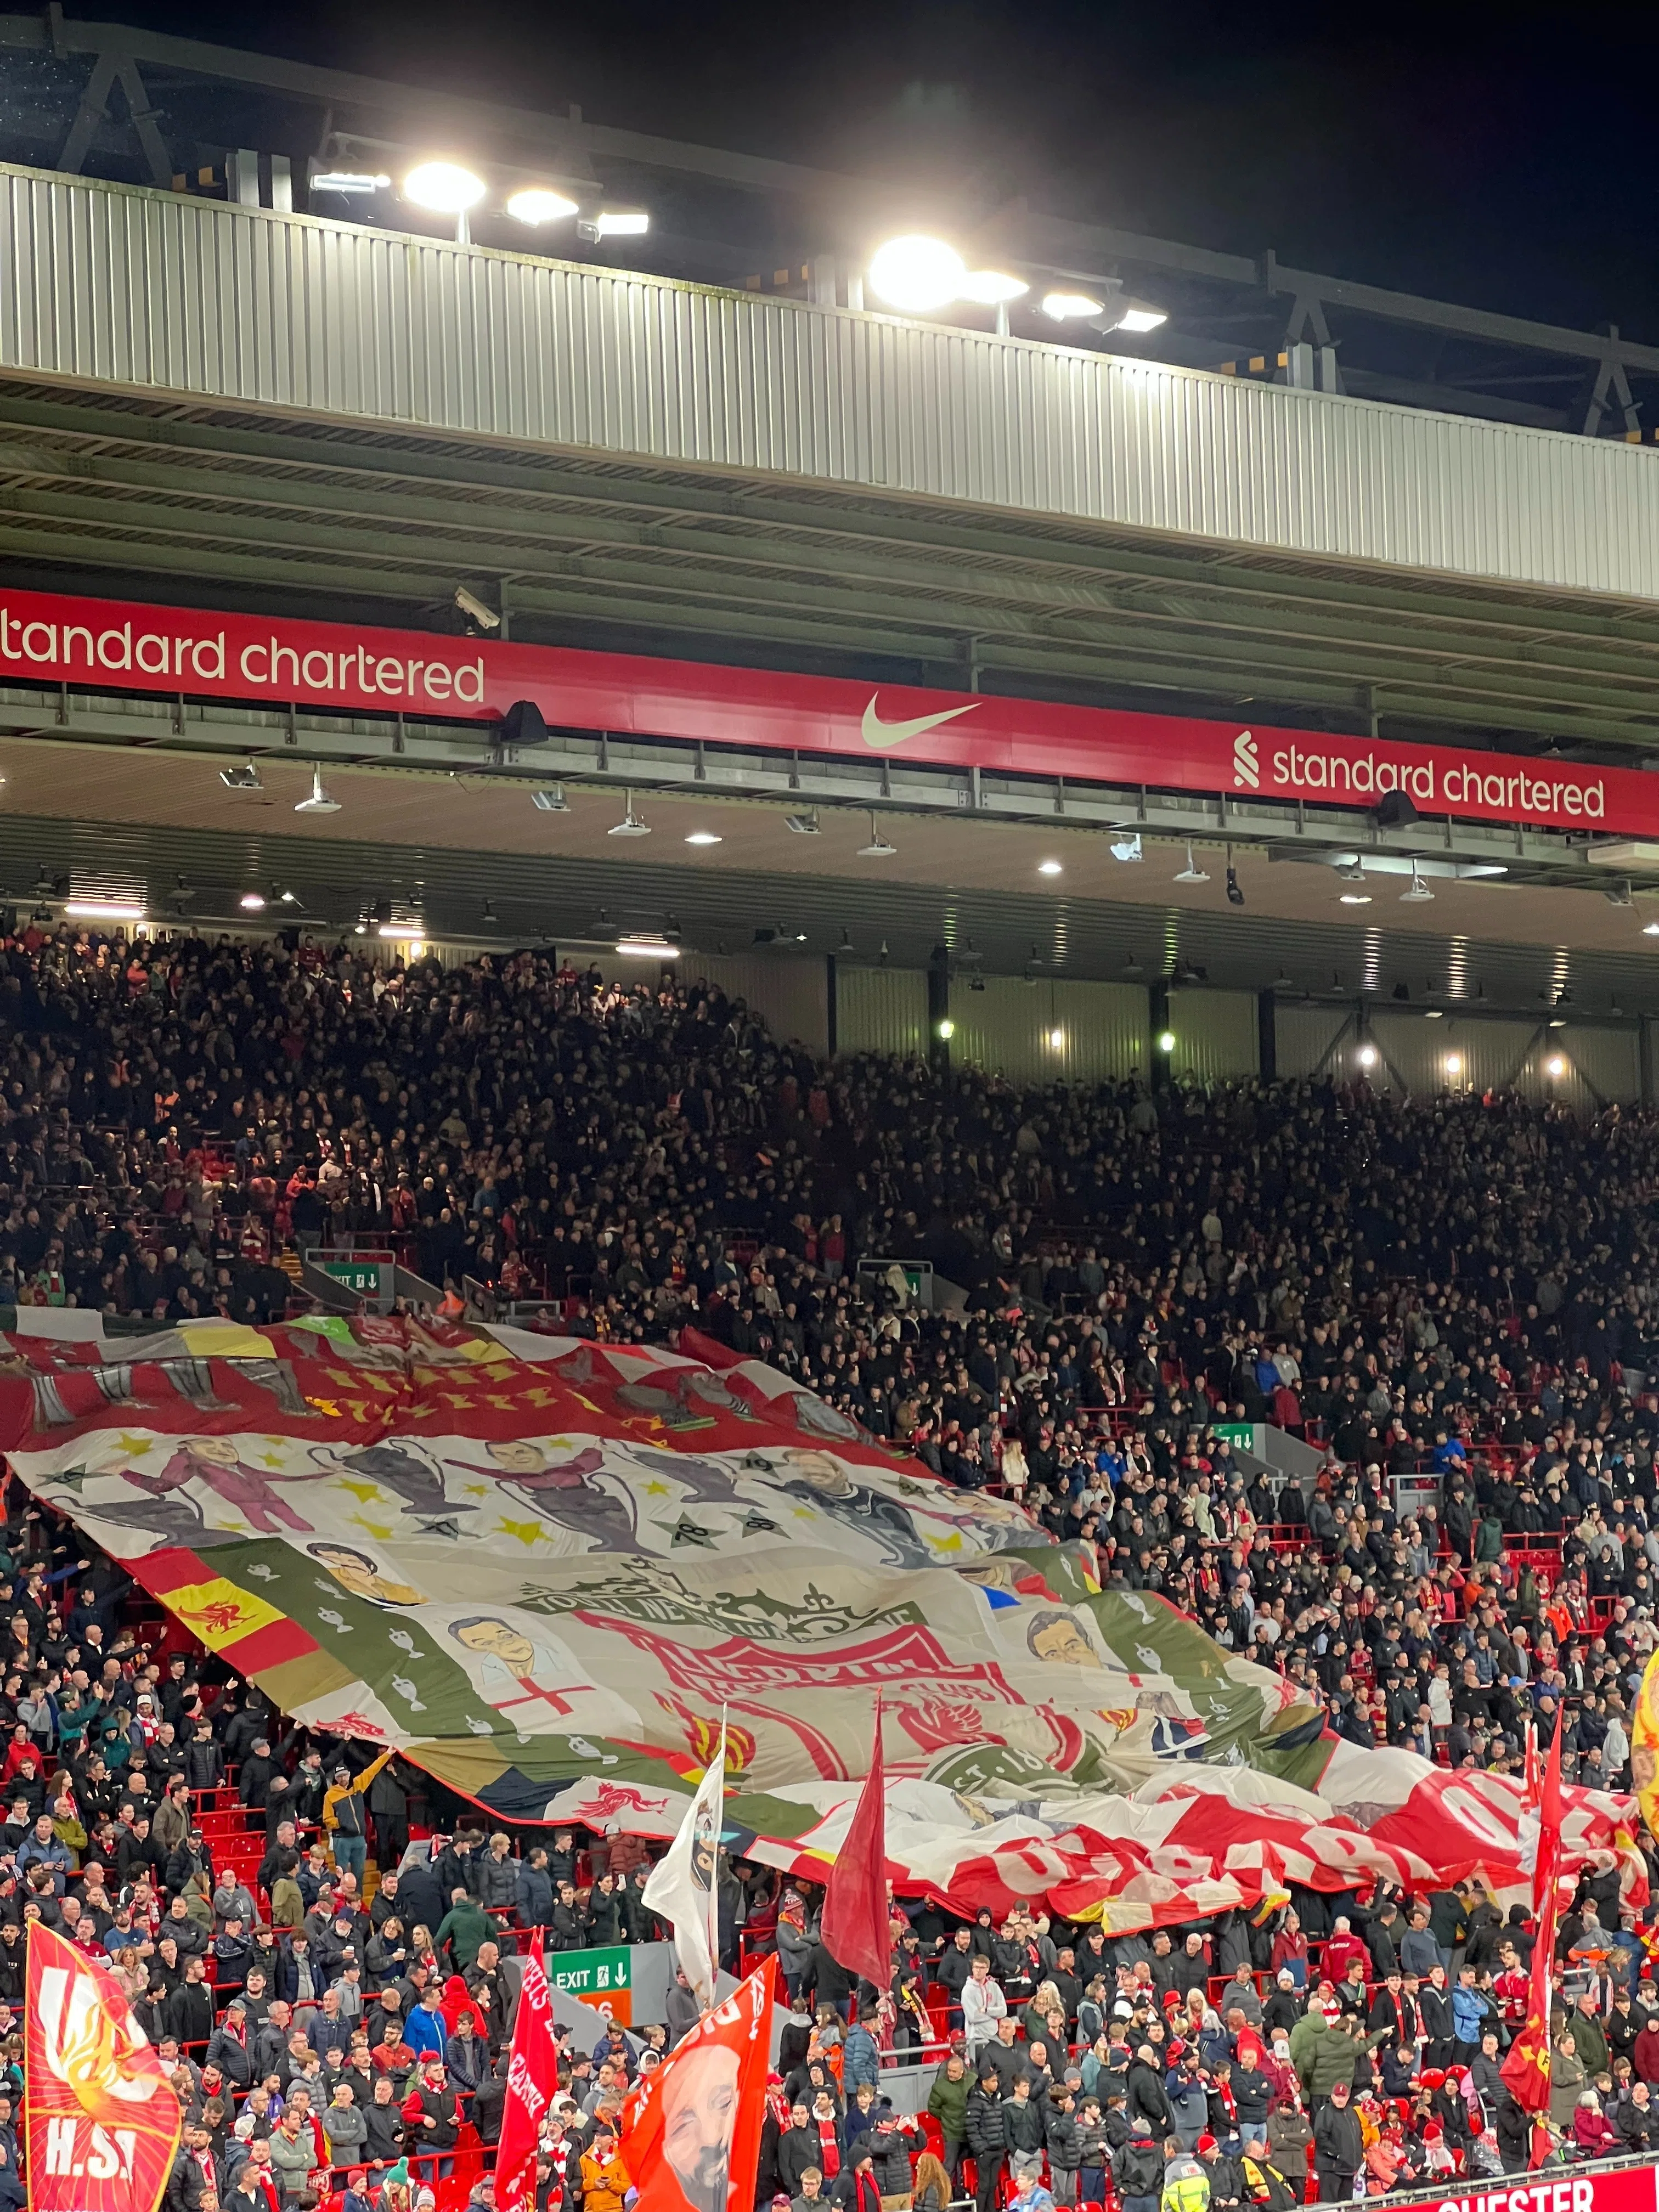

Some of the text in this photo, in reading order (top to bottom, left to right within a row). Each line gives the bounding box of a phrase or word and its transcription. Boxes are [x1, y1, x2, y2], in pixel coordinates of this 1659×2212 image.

[1, 608, 484, 703] tandard chartered
[1273, 744, 1605, 817] standard chartered
[335, 1276, 351, 1286] XIT
[674, 1523, 709, 1545] 78
[556, 1970, 590, 1989] EXIT
[1437, 2179, 1595, 2212] STER
